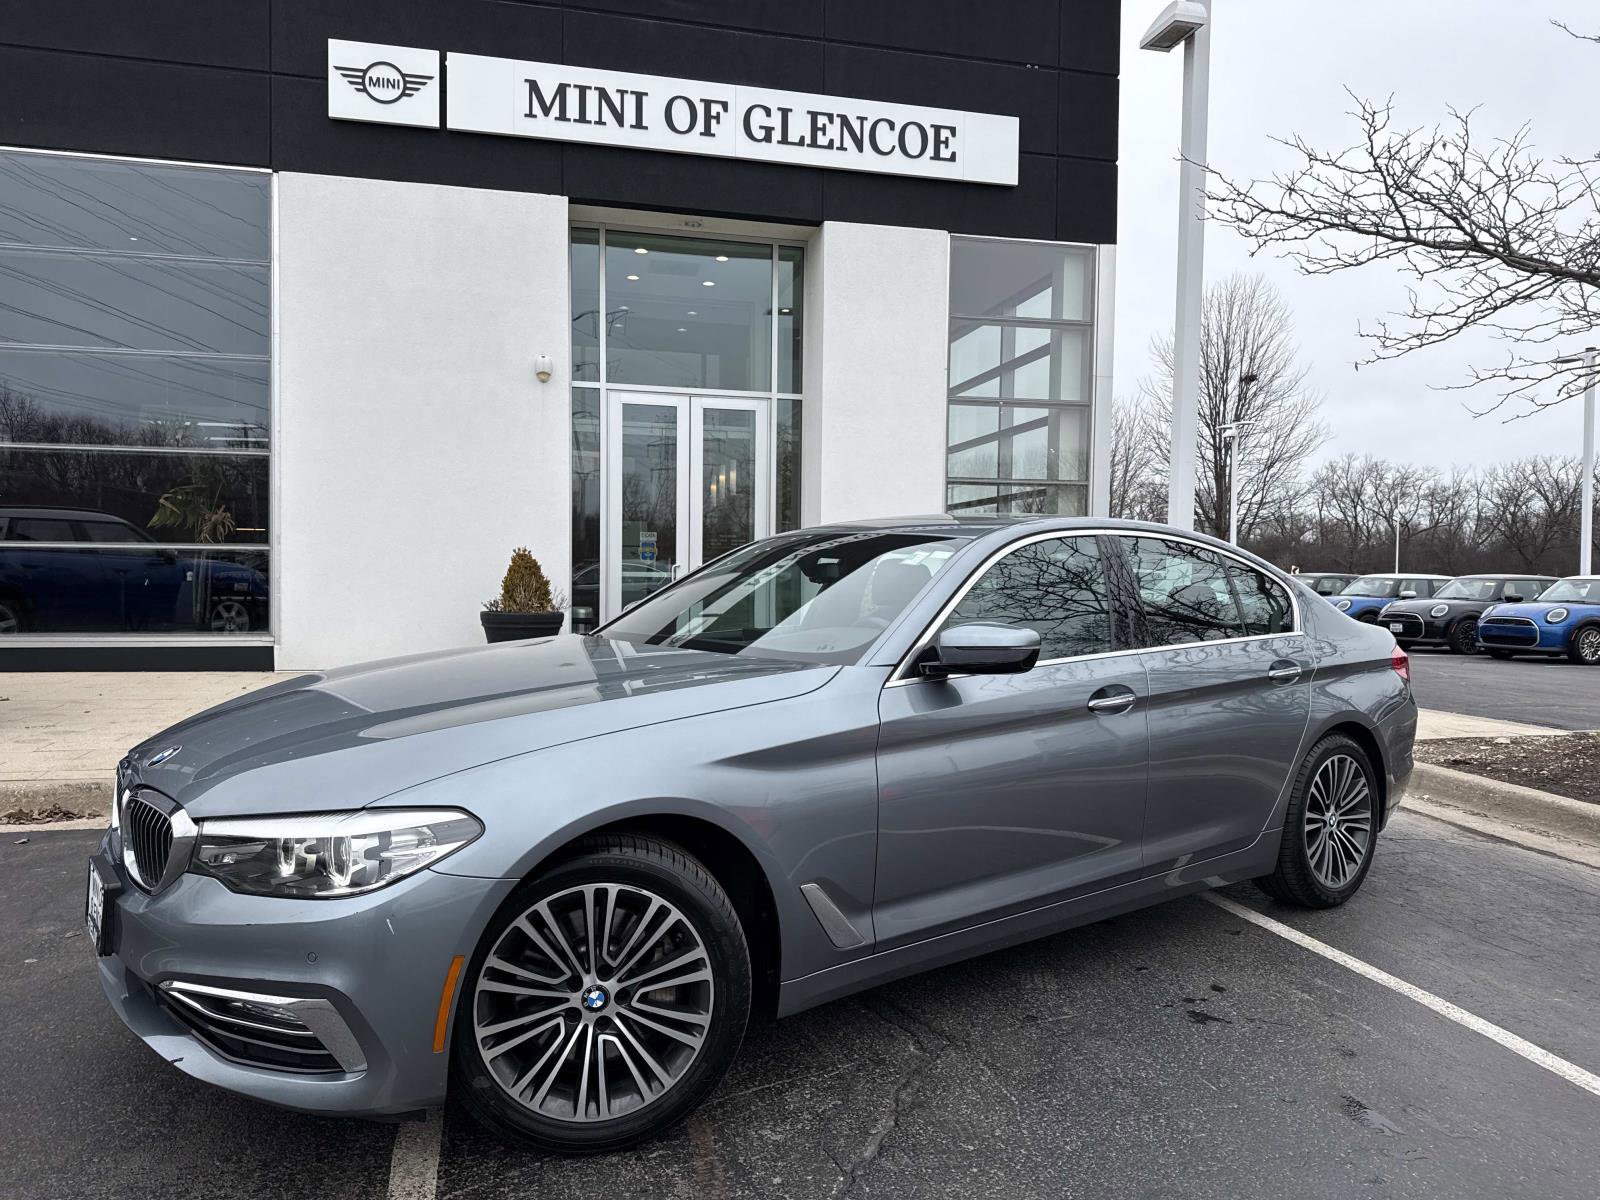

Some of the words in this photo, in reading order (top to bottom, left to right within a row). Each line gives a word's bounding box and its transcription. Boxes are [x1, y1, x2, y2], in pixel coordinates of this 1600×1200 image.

[369, 75, 401, 91] MINI
[523, 78, 649, 131] MINI
[664, 95, 729, 138] OF
[742, 103, 957, 163] GLENCOE
